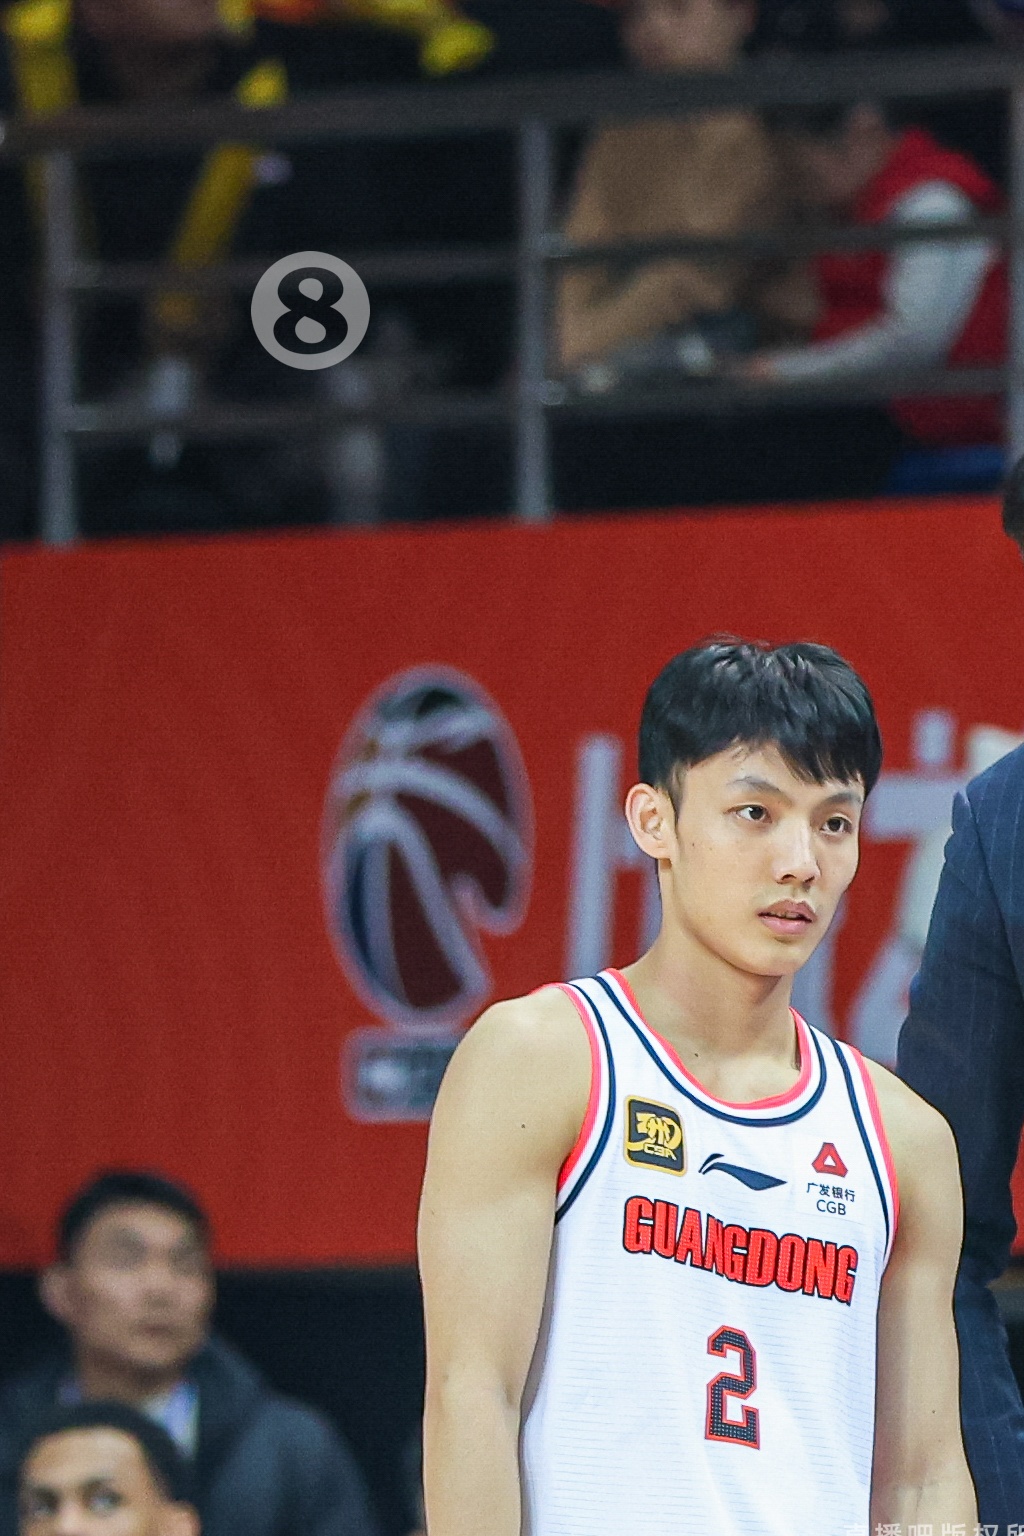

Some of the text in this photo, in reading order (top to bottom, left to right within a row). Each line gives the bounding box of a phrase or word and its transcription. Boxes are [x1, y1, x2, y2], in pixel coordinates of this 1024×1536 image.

[806, 1182, 856, 1203] 广发银行
[816, 1199, 847, 1216] CGB
[623, 1195, 859, 1306] GUANGDONG
[704, 1324, 761, 1451] 2
